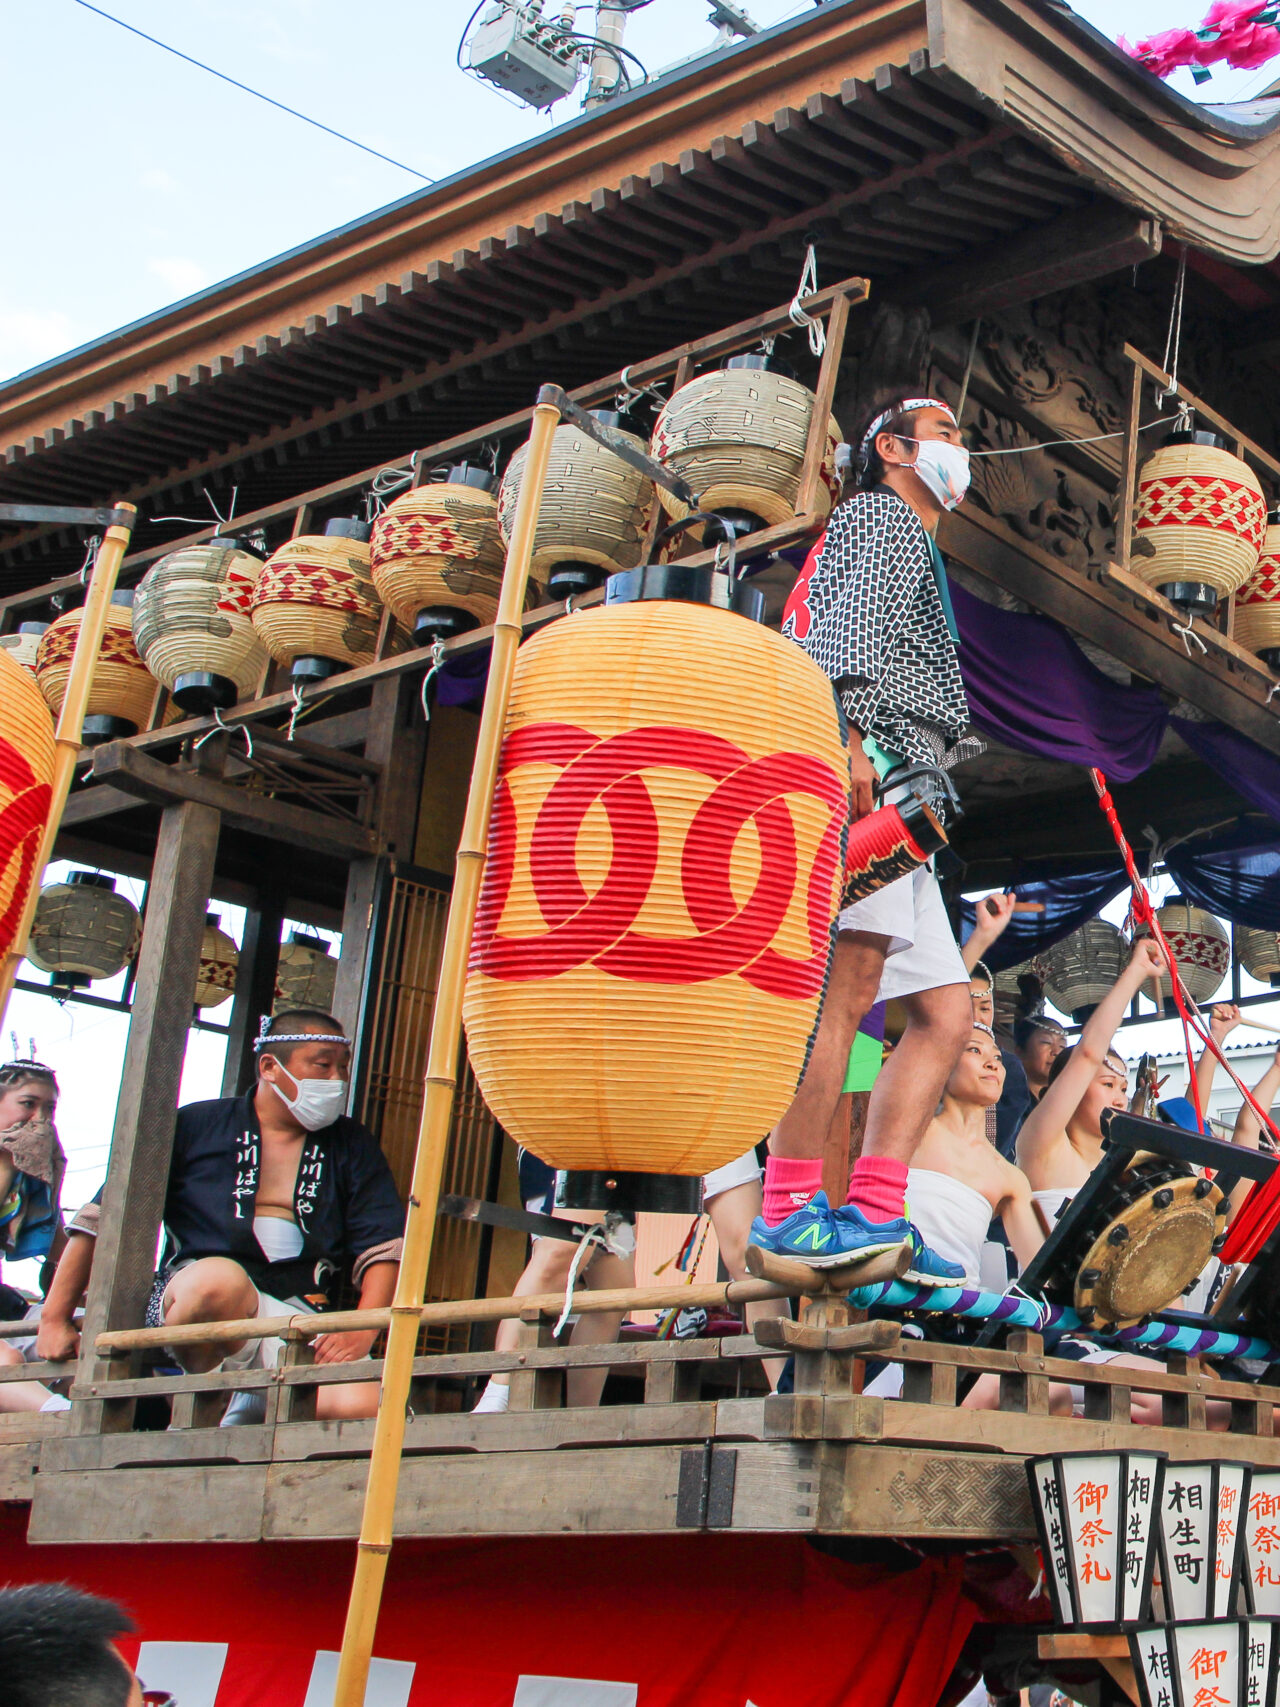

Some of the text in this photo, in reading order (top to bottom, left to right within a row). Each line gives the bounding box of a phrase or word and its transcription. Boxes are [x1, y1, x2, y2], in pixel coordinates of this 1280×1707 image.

[232, 1130, 258, 1219] 小川ばやし
[296, 1144, 325, 1234] 小川ばやし
[1072, 1480, 1113, 1584] 御祭礼
[1125, 1469, 1150, 1588] 相生町
[1168, 1481, 1204, 1584] 相生町
[1215, 1485, 1237, 1581] 御祭礼
